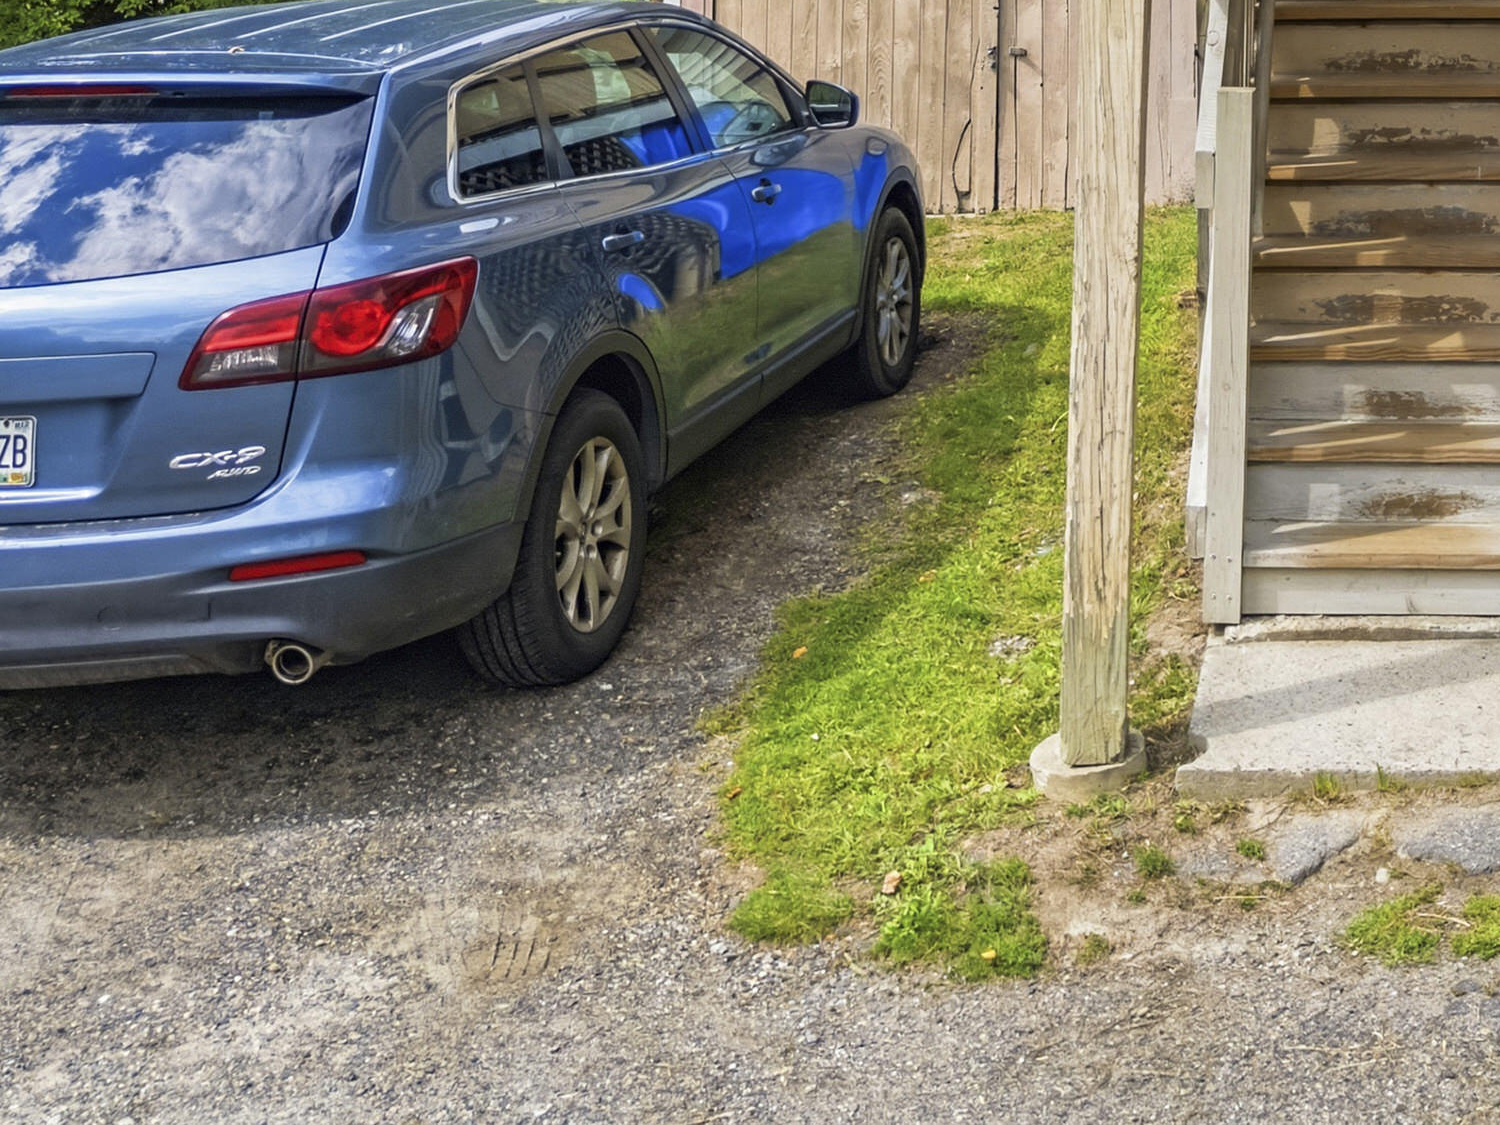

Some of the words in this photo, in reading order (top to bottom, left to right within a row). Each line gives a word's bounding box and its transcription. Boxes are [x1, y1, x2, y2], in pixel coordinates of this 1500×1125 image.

[0, 434, 28, 469] ZB
[169, 446, 266, 469] CX-9
[206, 465, 262, 480] AWD
